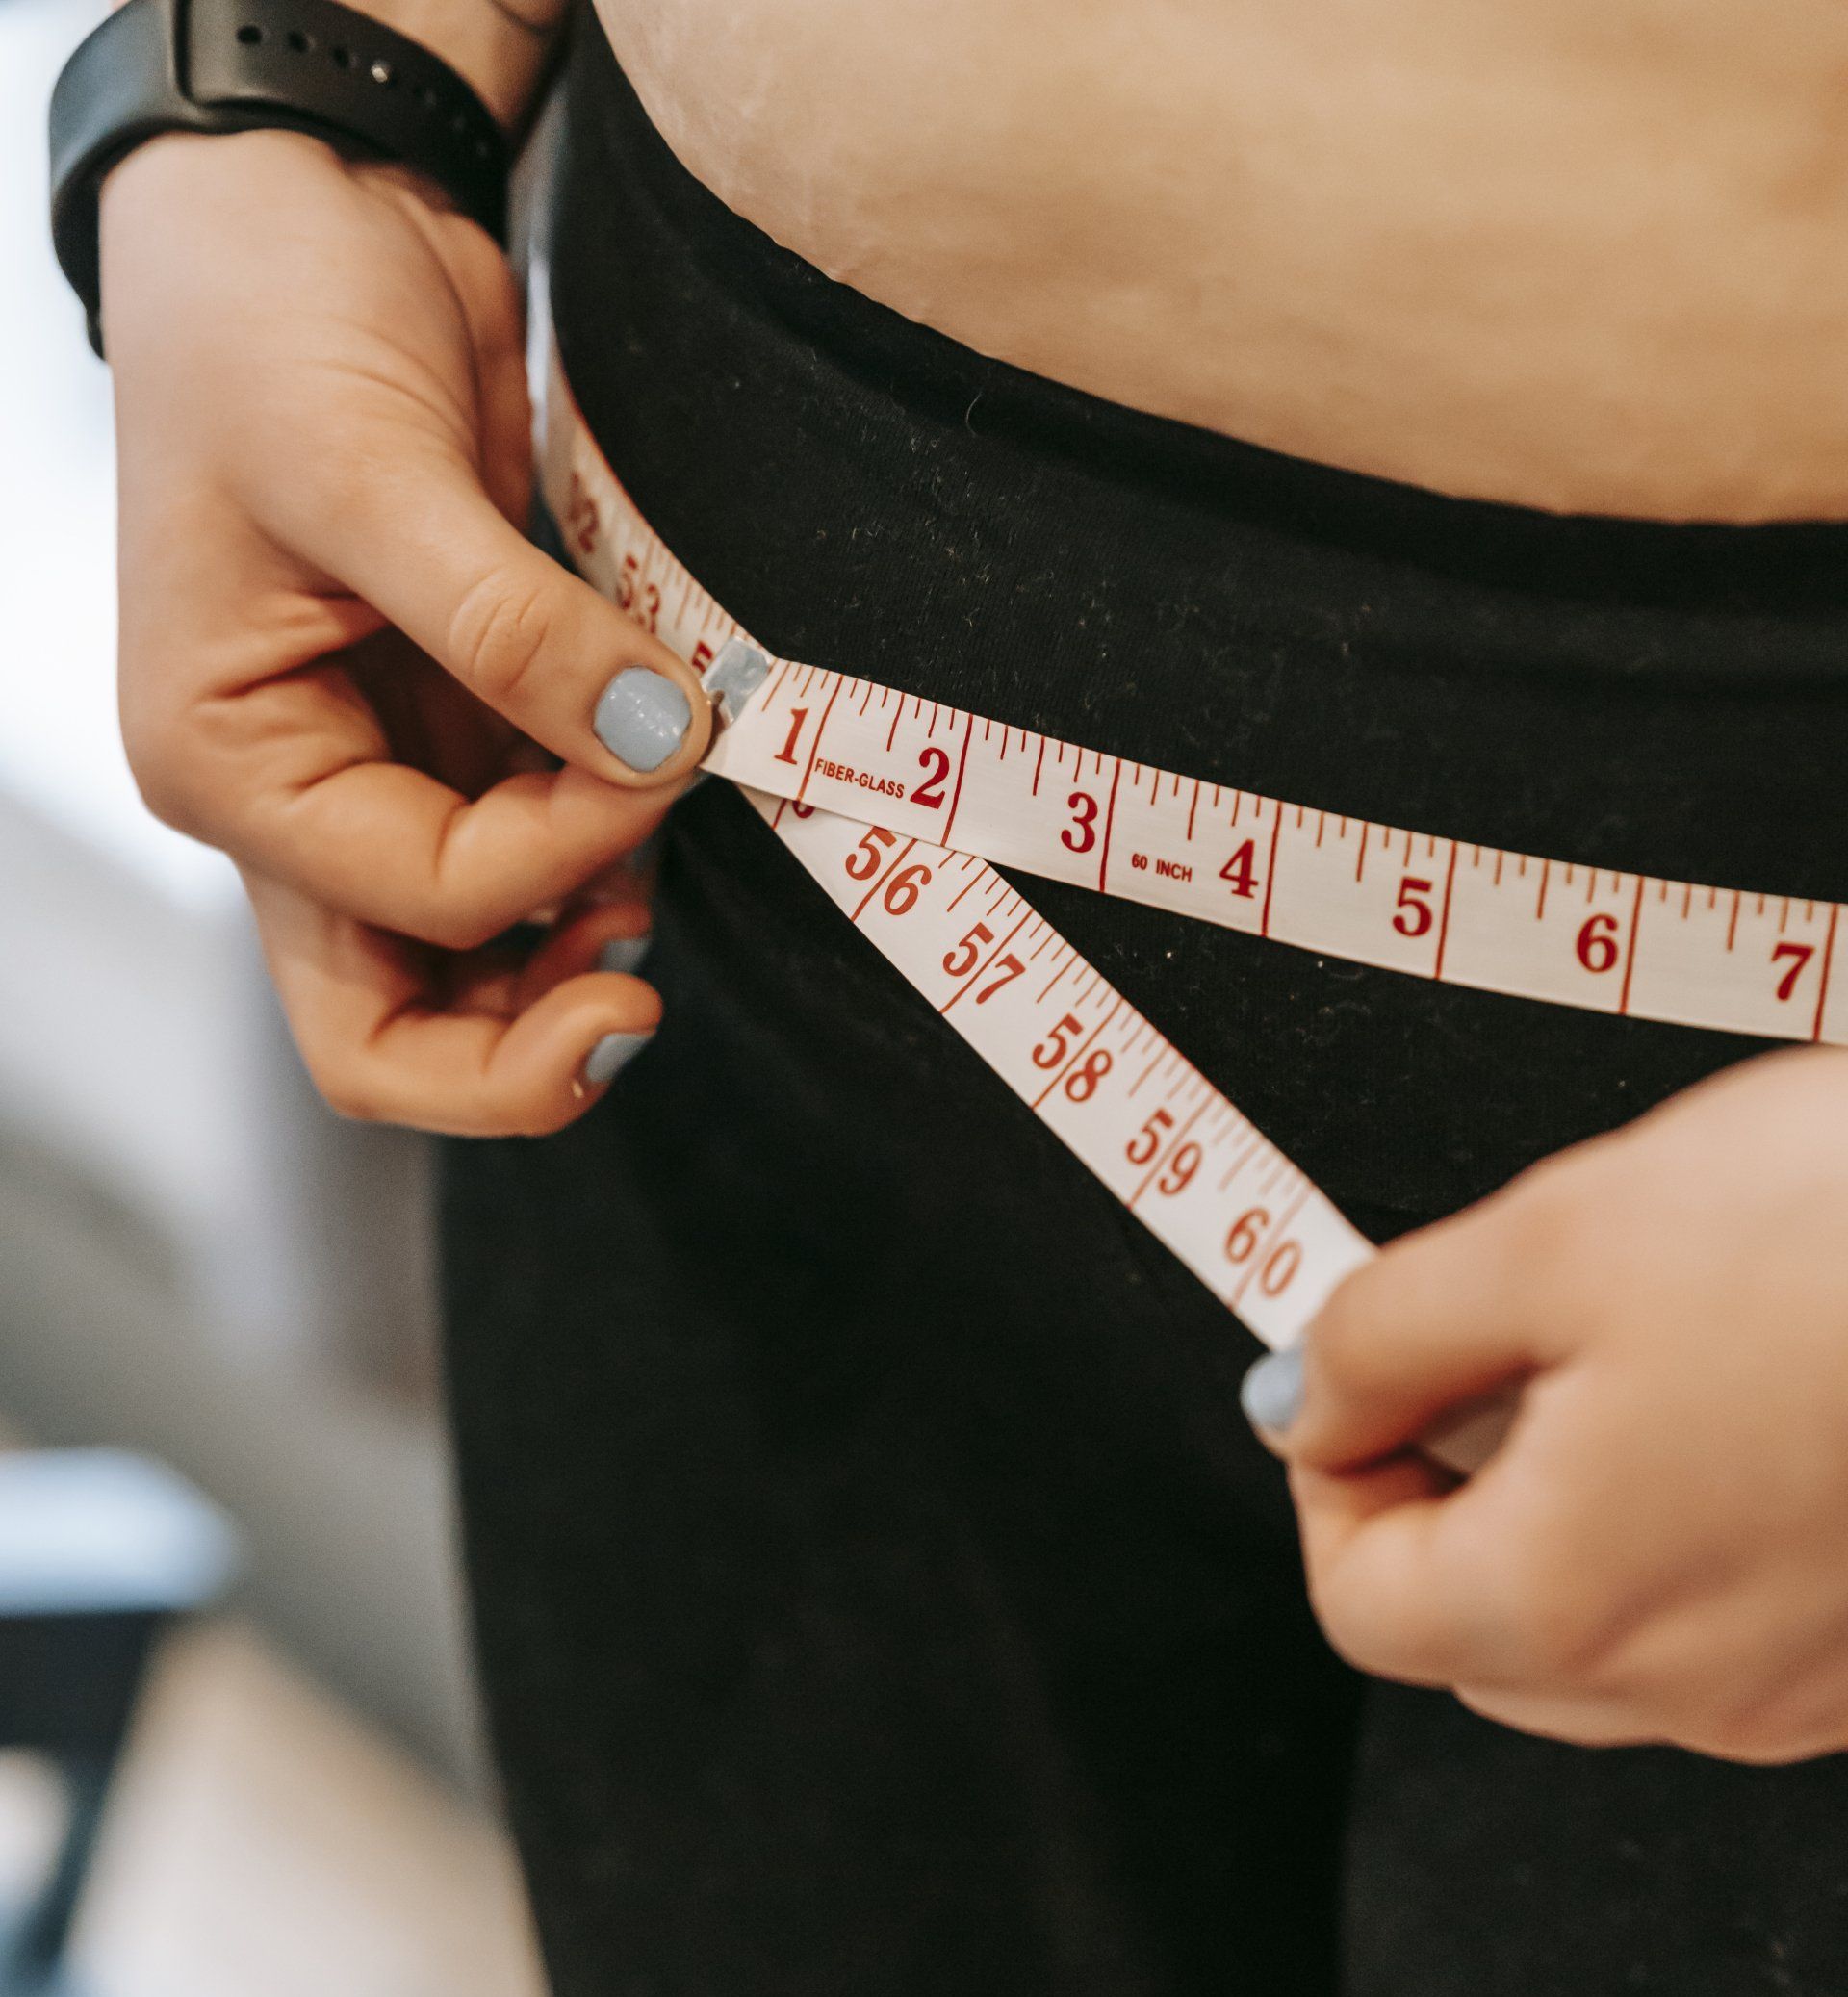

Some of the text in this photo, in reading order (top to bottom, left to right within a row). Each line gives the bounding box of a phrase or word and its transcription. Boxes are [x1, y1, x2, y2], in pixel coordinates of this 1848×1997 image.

[774, 708, 808, 765] 1
[814, 758, 905, 799] FIBER-GLASS
[910, 747, 951, 809] 2
[1061, 792, 1099, 854] 3
[845, 826, 932, 915] 56
[1132, 853, 1193, 882] 60 INCH
[1219, 839, 1259, 899] 4
[1392, 877, 1433, 936] 5
[942, 922, 1026, 1004] 57
[1576, 913, 1619, 973] 6
[1771, 942, 1814, 1001] 7
[1032, 1013, 1113, 1102] 58
[1125, 1109, 1202, 1196] 59
[1223, 1207, 1302, 1299] 60
